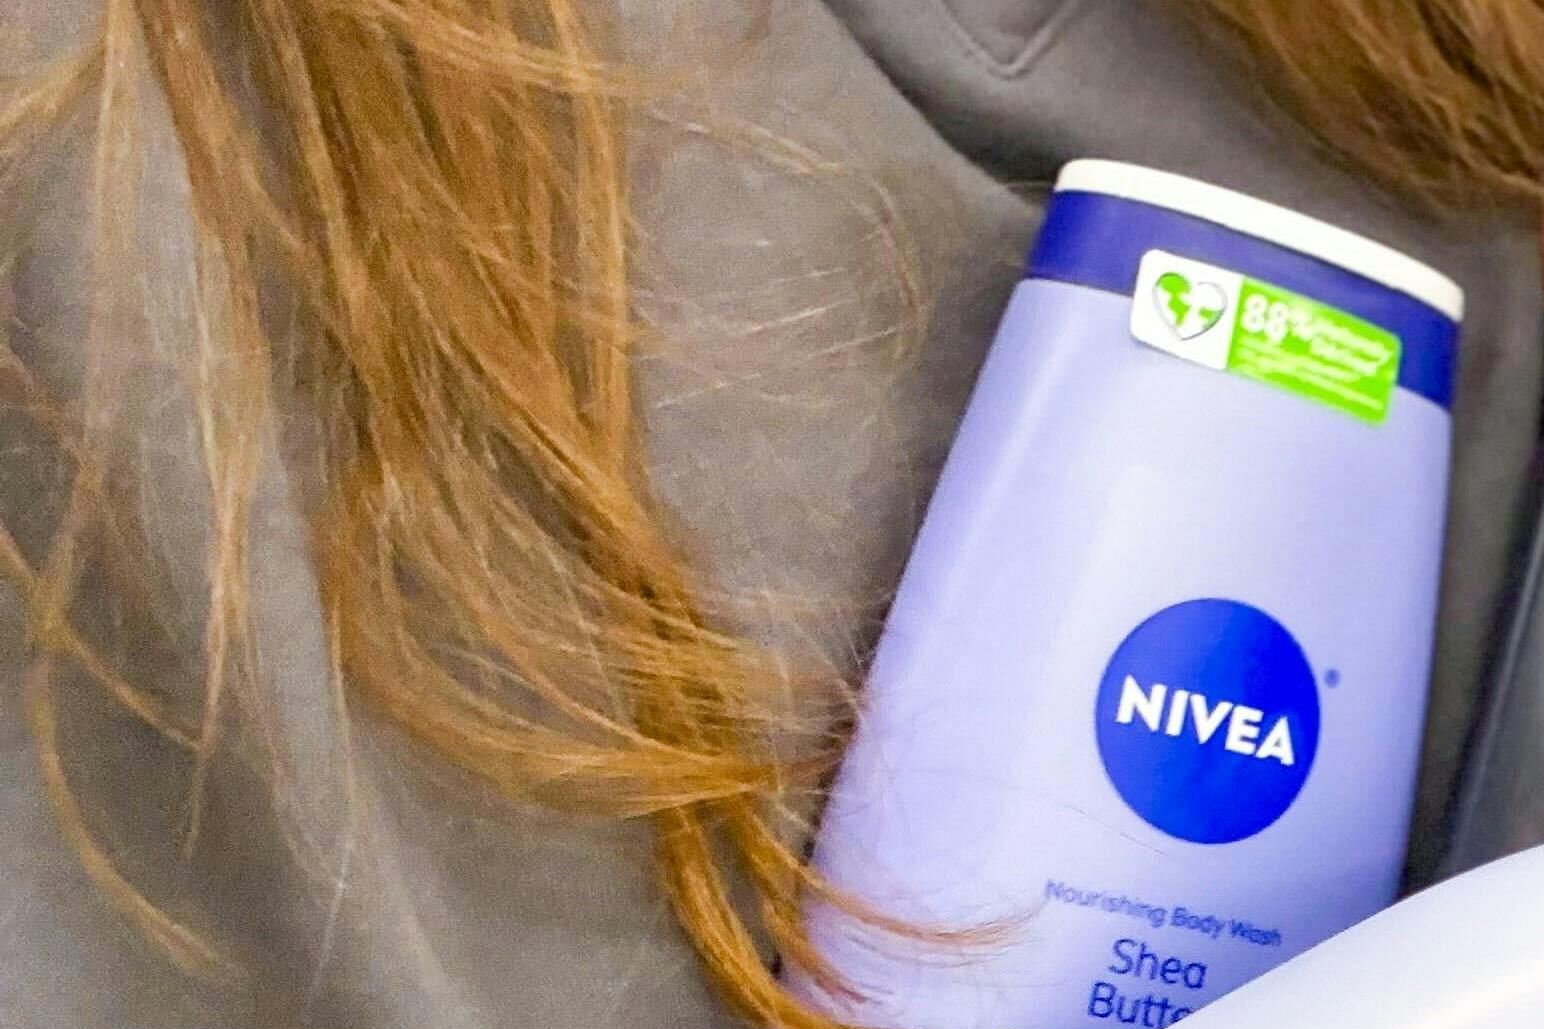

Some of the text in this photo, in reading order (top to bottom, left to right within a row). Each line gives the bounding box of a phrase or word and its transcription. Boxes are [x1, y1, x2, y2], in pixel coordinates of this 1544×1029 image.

[1116, 675, 1294, 765] NIVEA
[1046, 878, 1281, 946] Nourishing Body Wash
[1108, 938, 1207, 989] Shea
